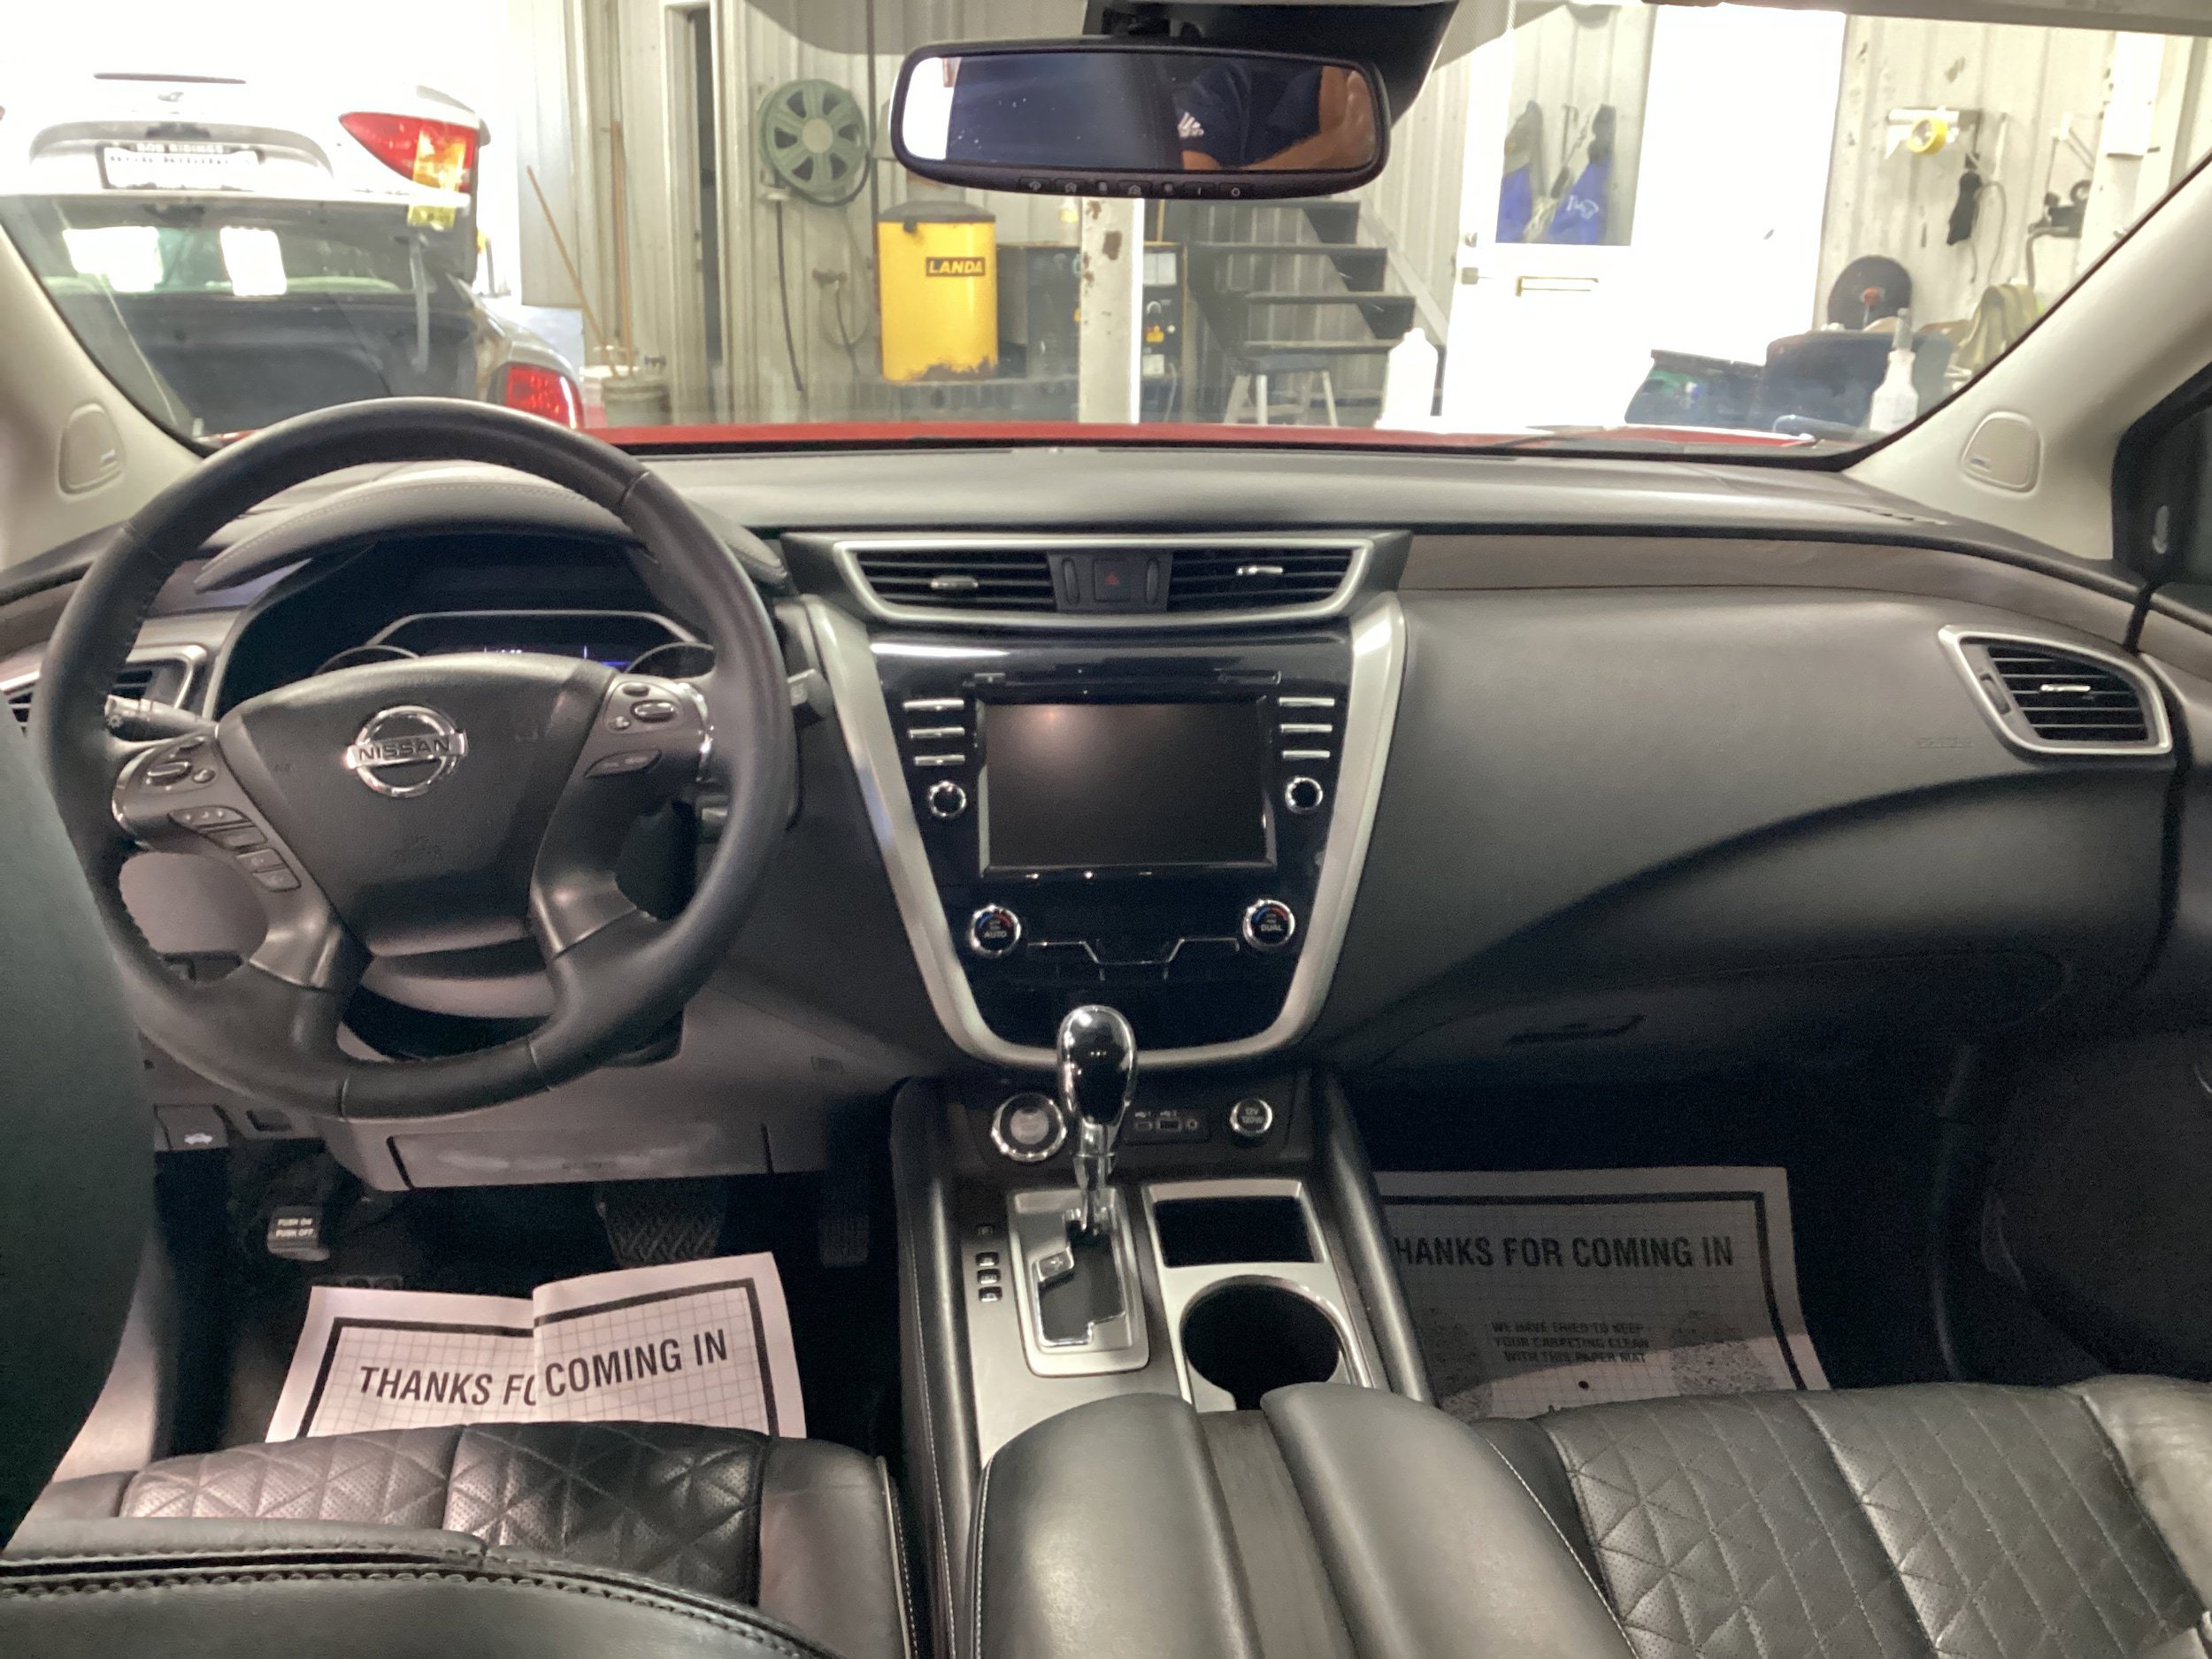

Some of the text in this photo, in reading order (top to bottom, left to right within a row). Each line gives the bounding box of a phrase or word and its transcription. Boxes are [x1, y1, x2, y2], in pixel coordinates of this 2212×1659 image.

[929, 260, 983, 273] LANDA
[359, 736, 449, 761] NISSAN
[275, 1229, 297, 1238] PUSH
[1393, 1236, 1733, 1267] HANKS FOR COMING IN
[1492, 1322, 1512, 1333] WE
[1592, 1322, 1609, 1333] TO
[1612, 1322, 1644, 1333] KEEP
[1494, 1336, 1530, 1348] YOUR
[1504, 1351, 1538, 1363] WITH
[359, 1366, 493, 1406] THANKS
[544, 1338, 683, 1398] COMING
[694, 1329, 728, 1367] IN
